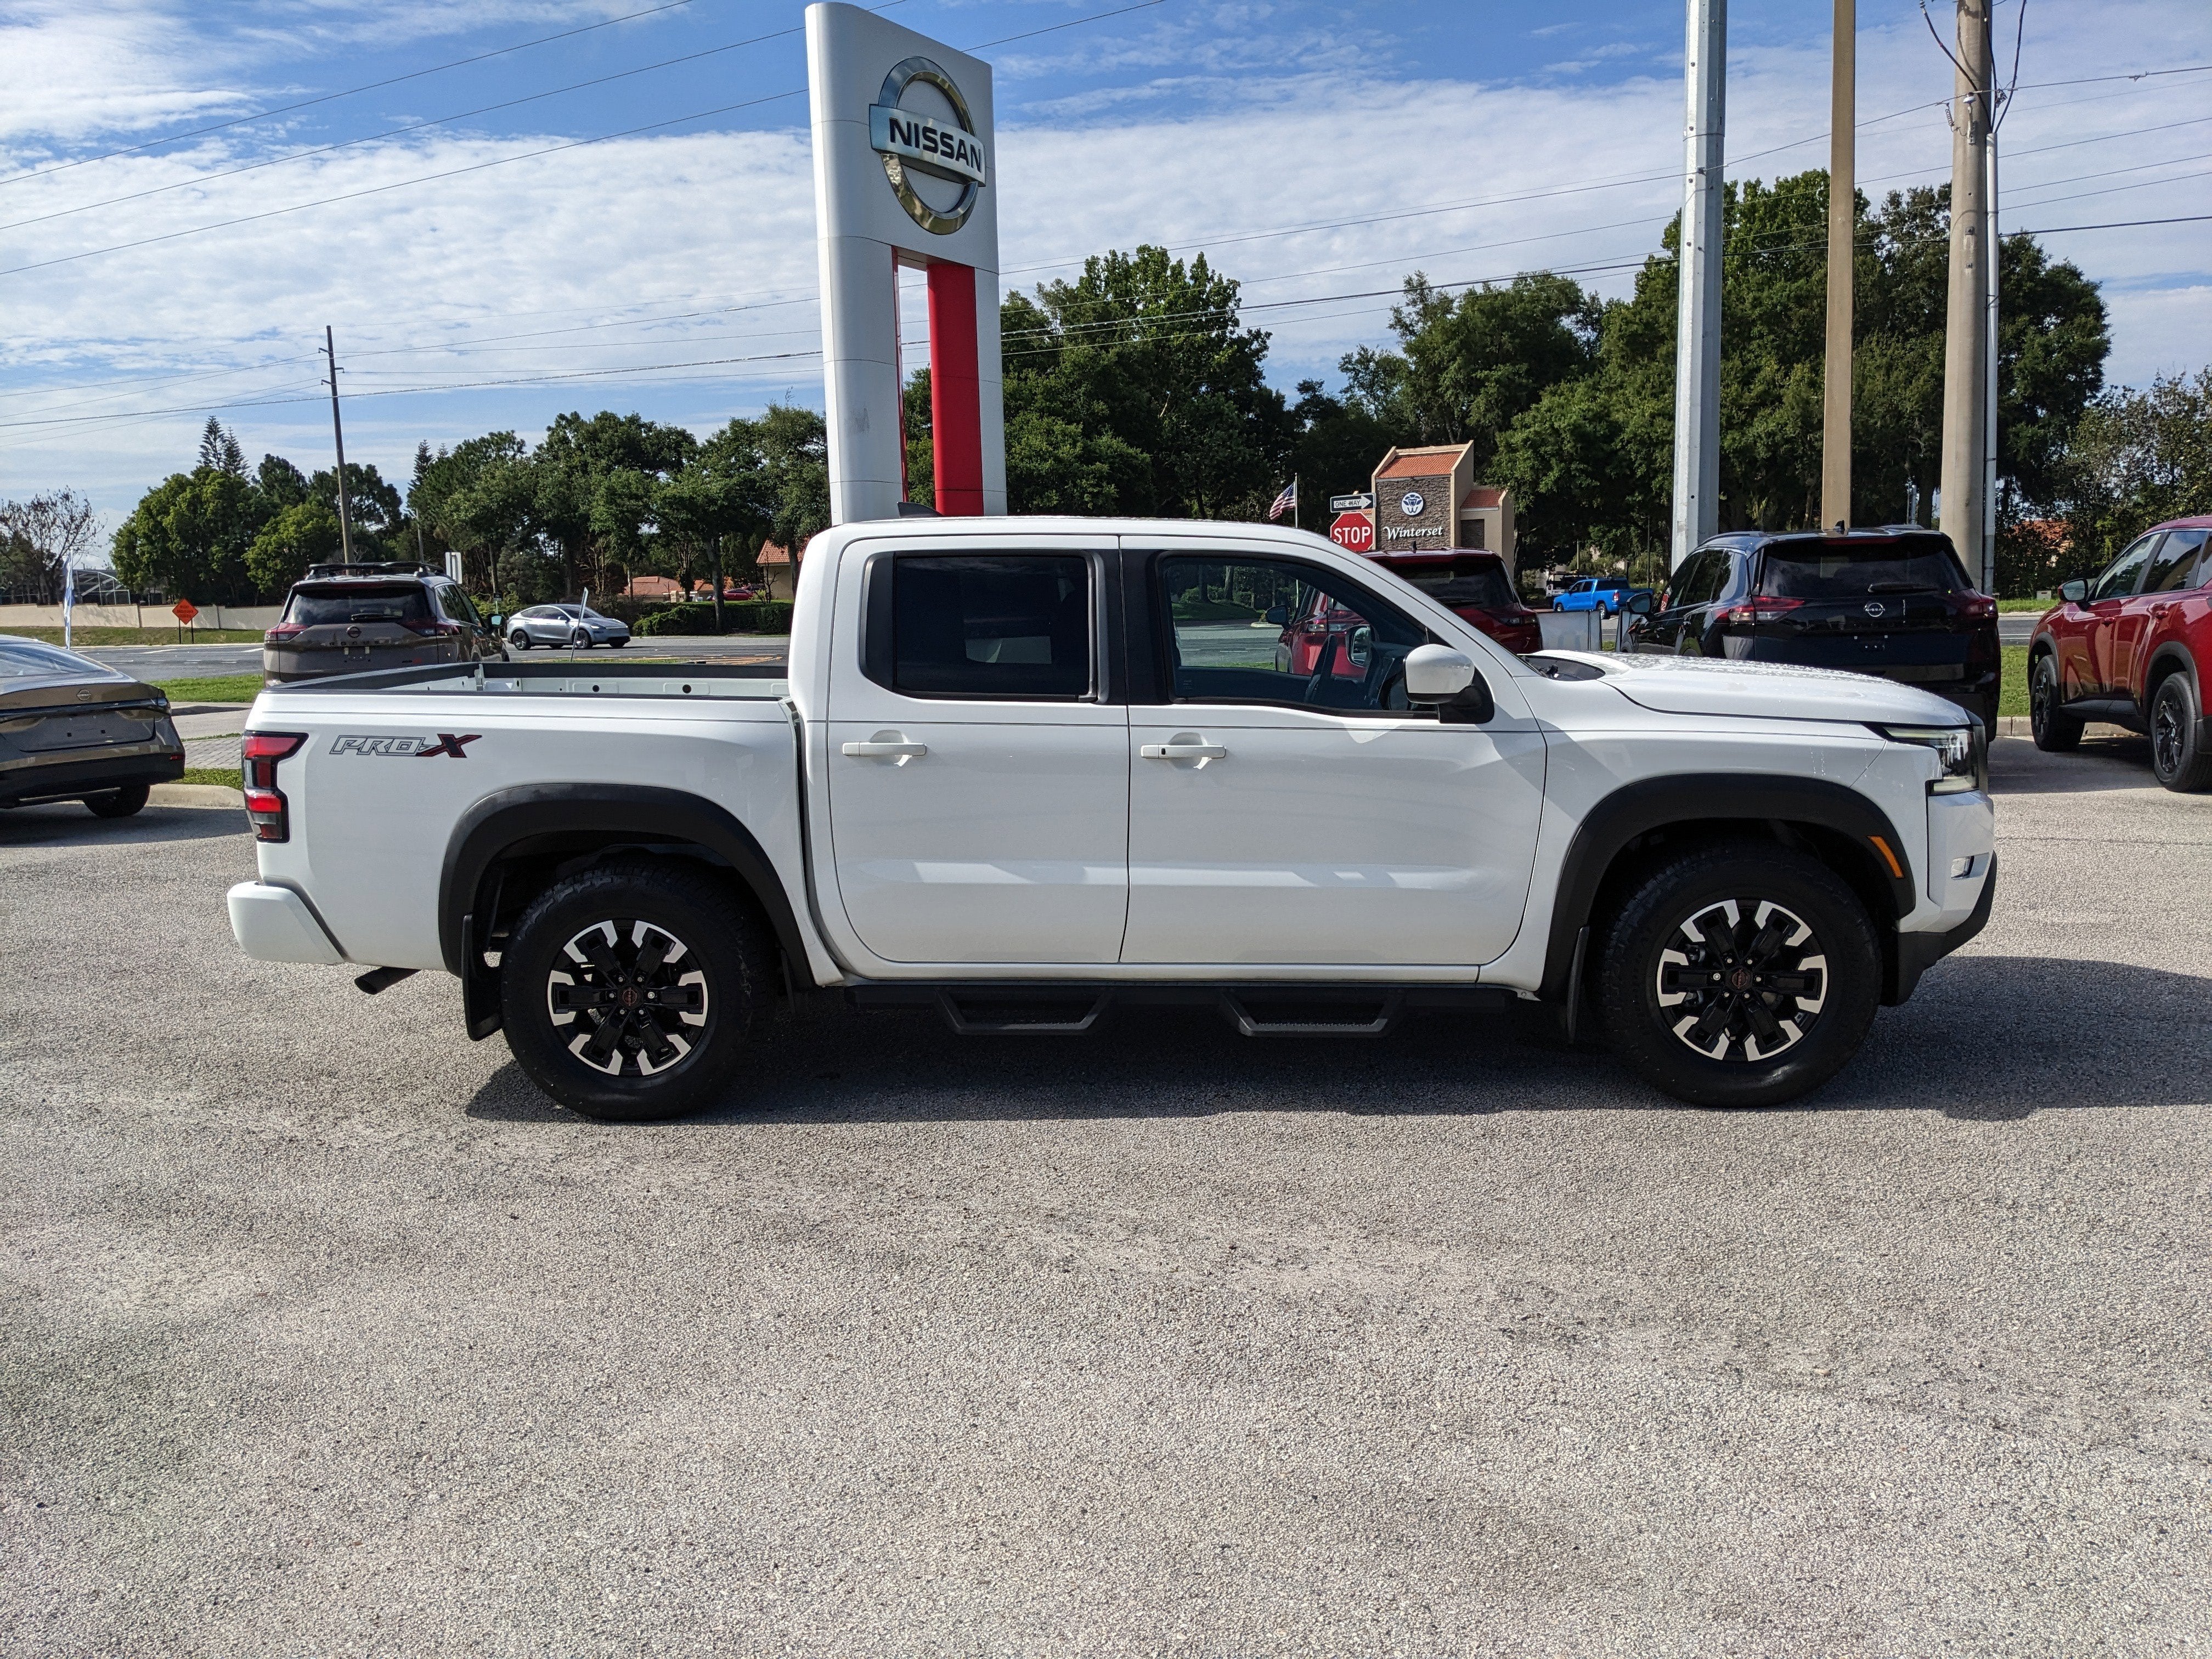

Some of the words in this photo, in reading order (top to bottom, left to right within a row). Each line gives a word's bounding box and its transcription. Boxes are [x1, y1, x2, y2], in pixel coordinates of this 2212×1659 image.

[889, 117, 981, 173] NISSAN
[1334, 526, 1371, 544] STOP
[1383, 526, 1443, 540] Winterset
